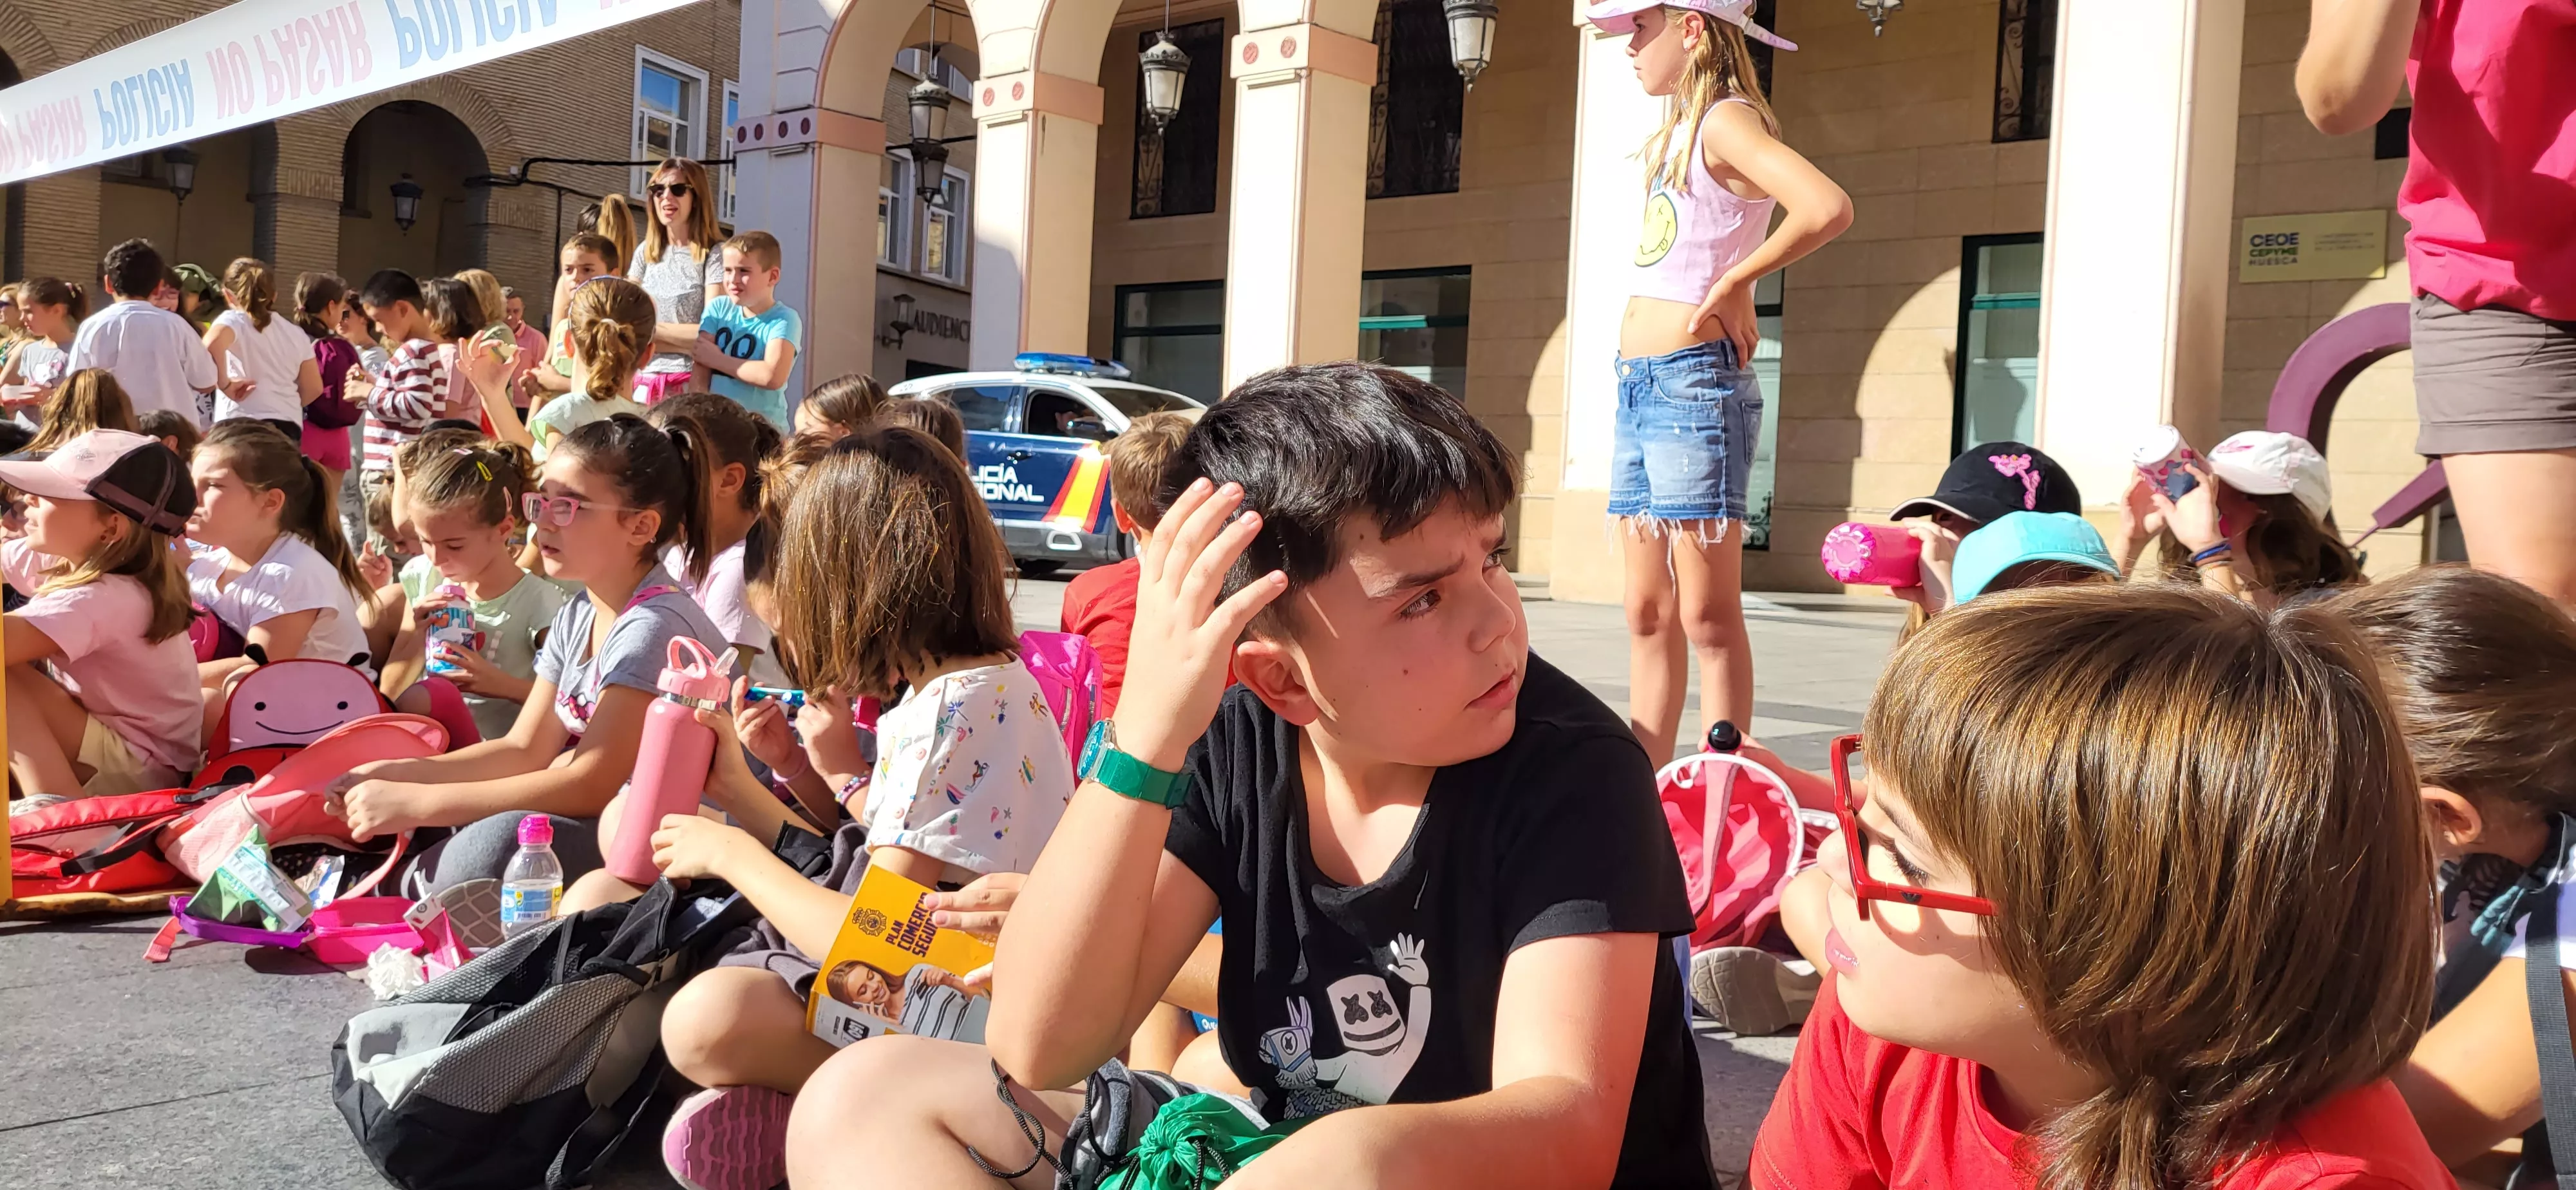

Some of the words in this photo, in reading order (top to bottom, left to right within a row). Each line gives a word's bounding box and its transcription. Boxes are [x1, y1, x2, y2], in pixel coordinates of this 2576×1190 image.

[2249, 232, 2300, 247] CEOE
[886, 920, 904, 945] PLAN
[912, 911, 938, 958] SEGUR
